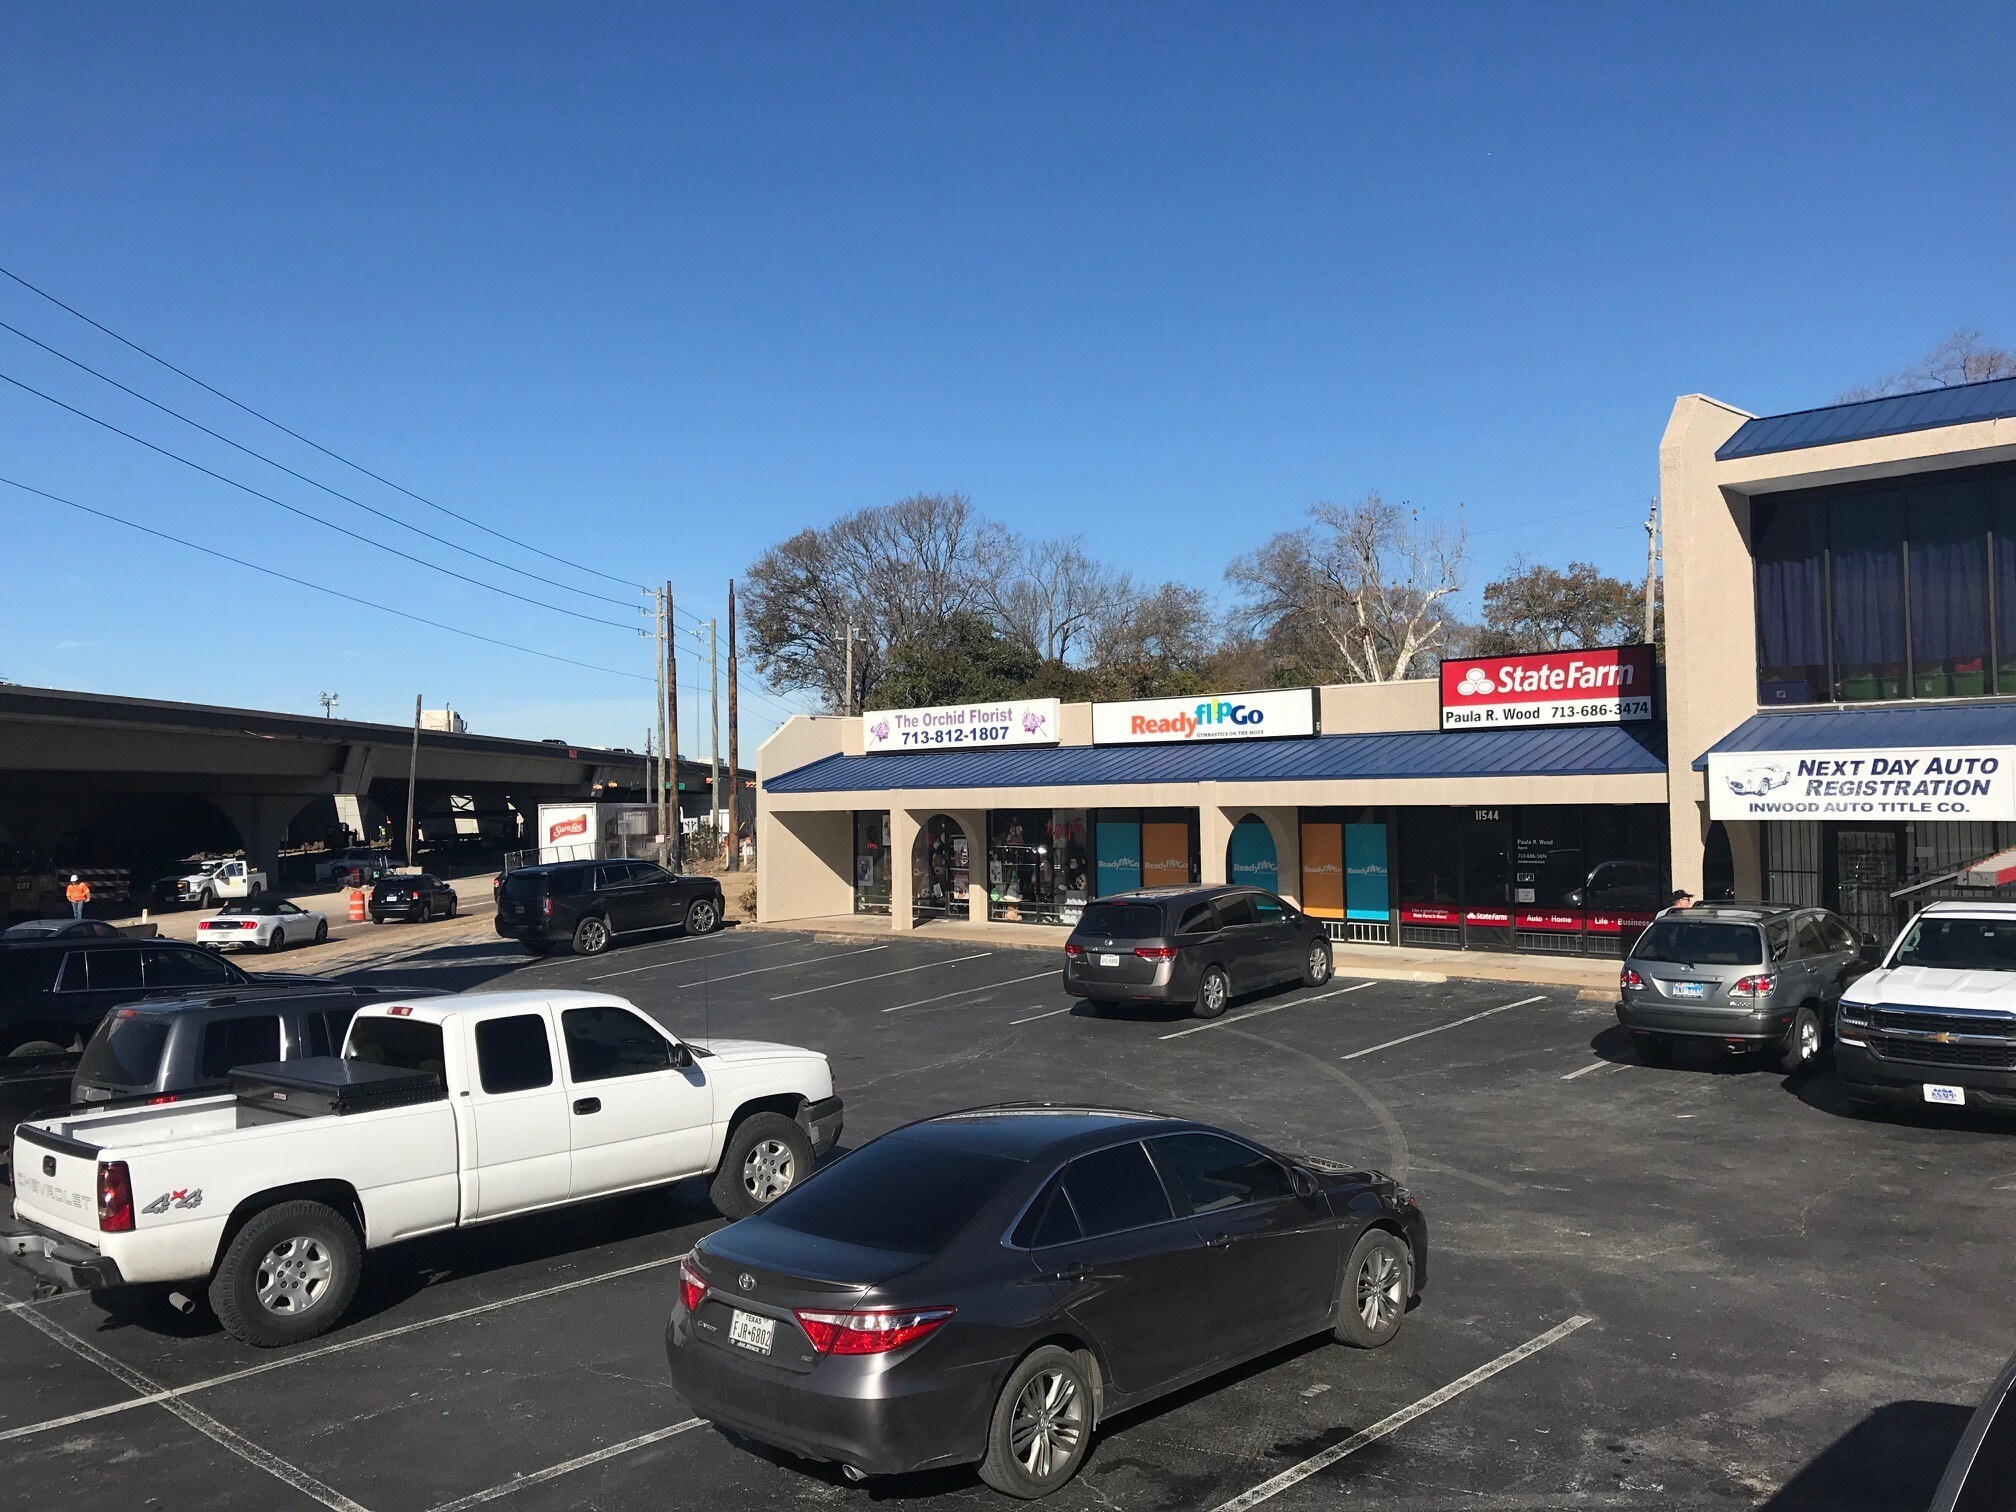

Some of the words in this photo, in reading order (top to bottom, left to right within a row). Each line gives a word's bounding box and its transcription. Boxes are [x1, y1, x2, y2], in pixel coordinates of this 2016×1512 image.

[895, 714, 919, 728] The
[923, 710, 965, 727] Orchid
[969, 707, 1013, 724] Florist
[1446, 710, 1481, 723] Paula
[1486, 709, 1498, 721] R.
[1503, 707, 1540, 720] Wood
[1551, 702, 1649, 718] 713-686-3474
[902, 726, 1009, 745] 713-812-1807
[1797, 760, 1865, 776] NEXT
[1871, 758, 1919, 776] DAY
[1924, 757, 1999, 775] AUTO
[1805, 779, 1991, 797] REGISTRATION
[1475, 810, 1499, 821] 11544
[1749, 802, 1819, 812] INWOOD
[1823, 802, 1873, 812] AUTO
[1878, 802, 1932, 812] TITLE
[1937, 802, 1970, 812] CO.
[1527, 914, 1543, 922] Auto
[1551, 915, 1572, 923] Home
[1595, 917, 1608, 925] Life
[1617, 918, 1649, 927] Business
[17, 1172, 91, 1210] CHEVROLET
[745, 1314, 762, 1325] TEXAS
